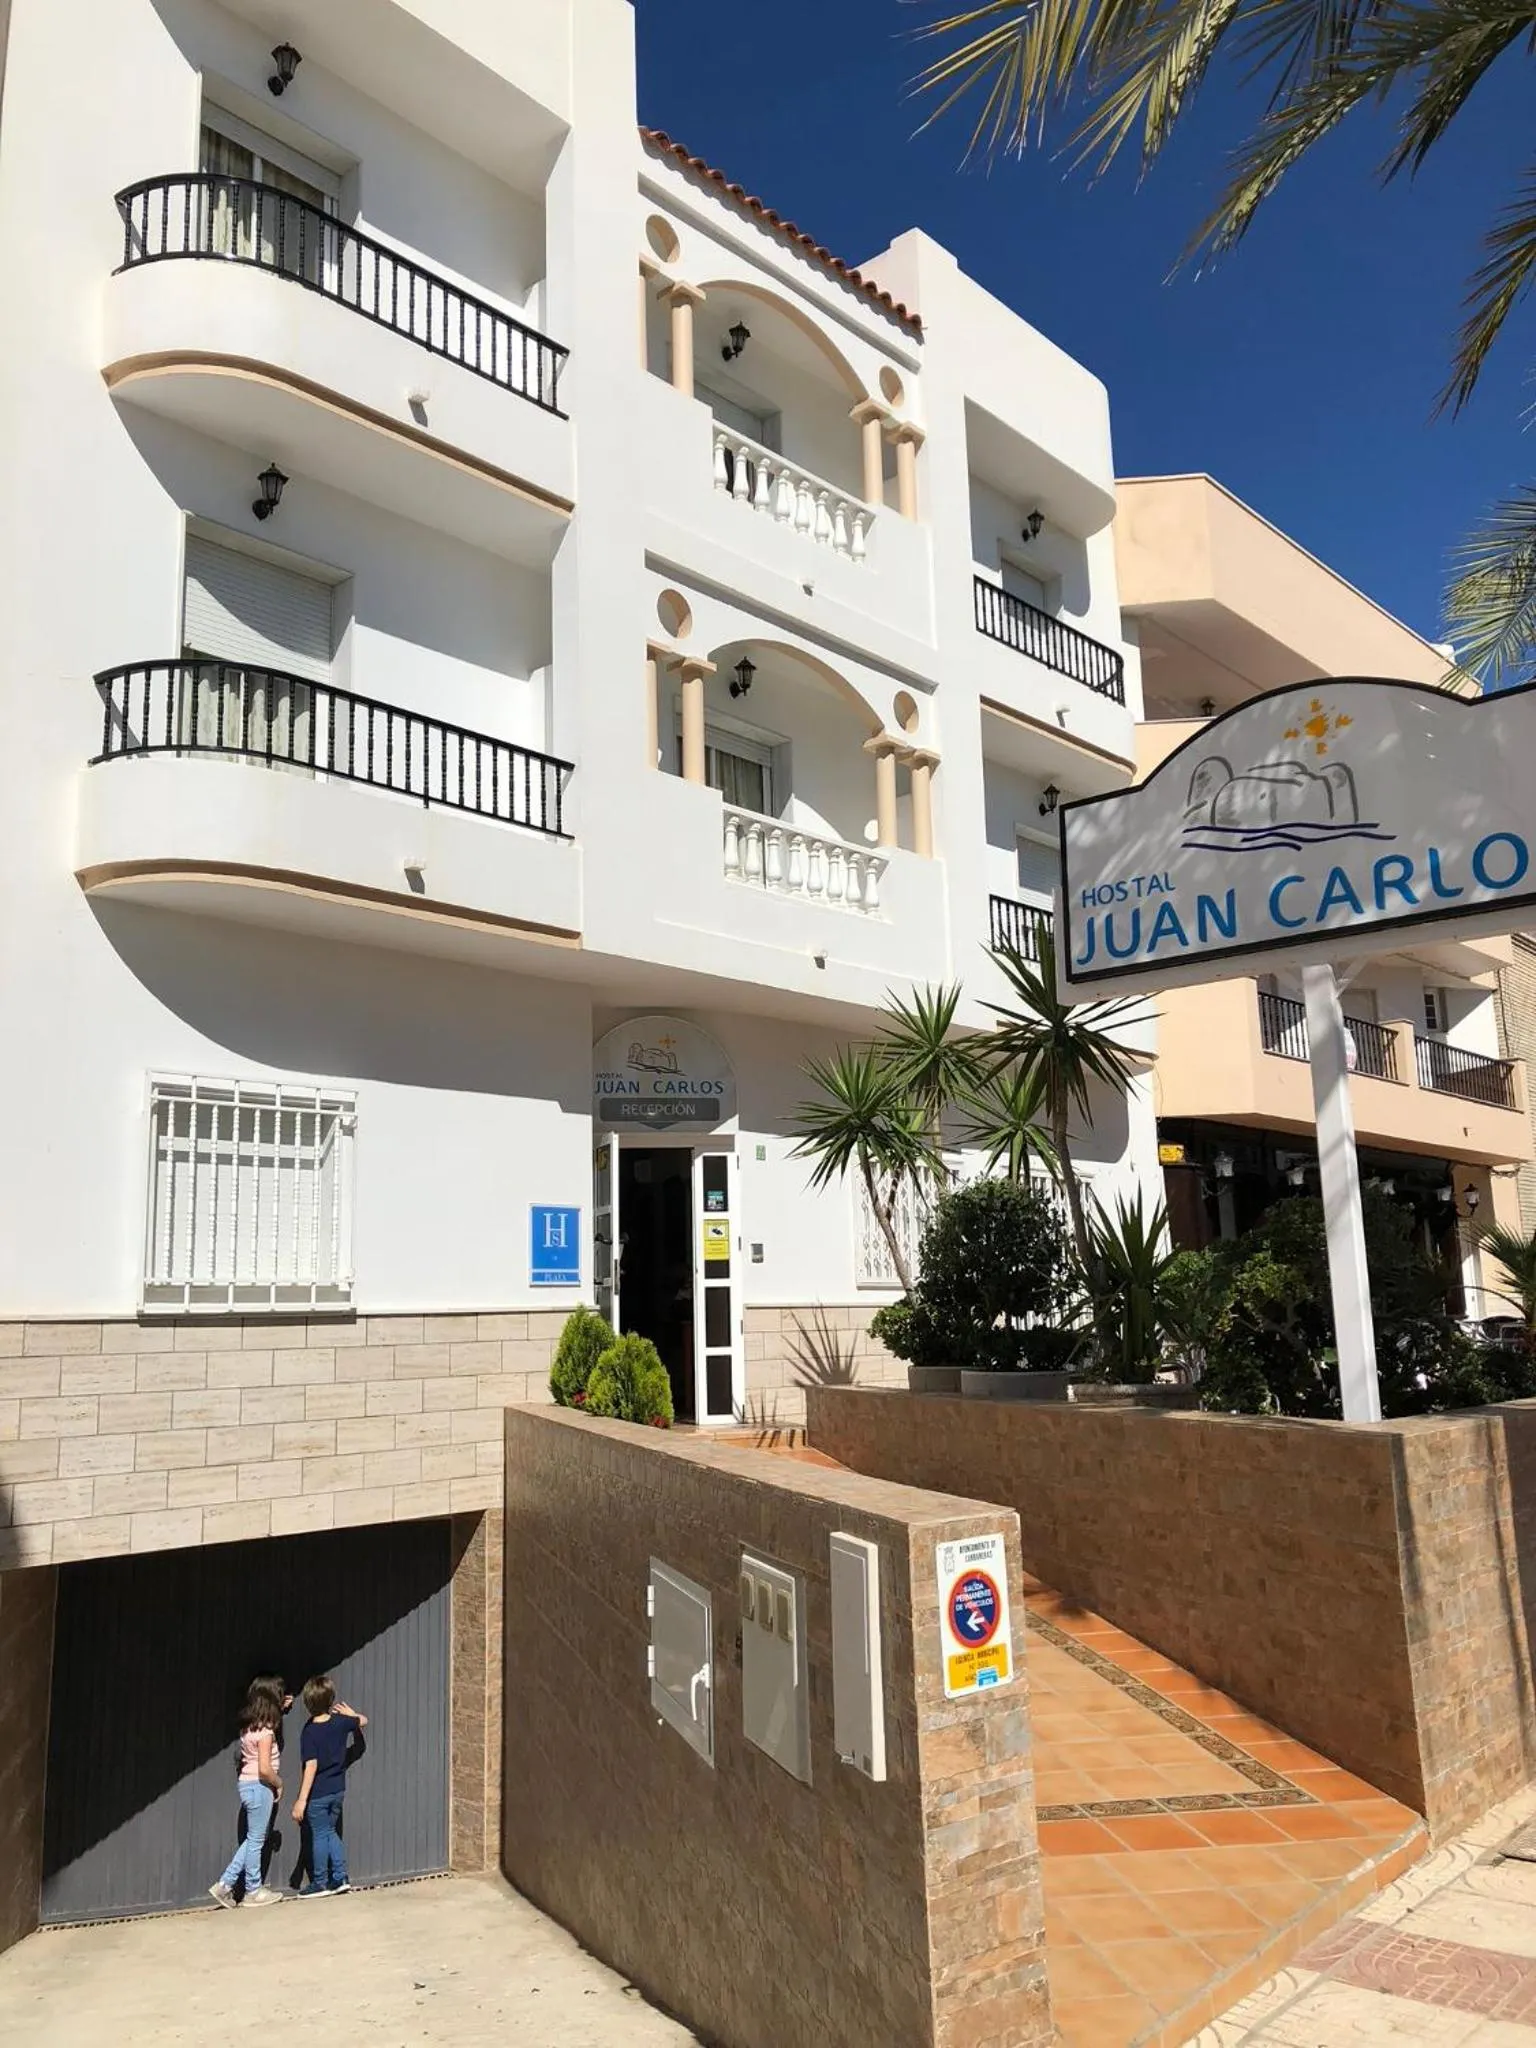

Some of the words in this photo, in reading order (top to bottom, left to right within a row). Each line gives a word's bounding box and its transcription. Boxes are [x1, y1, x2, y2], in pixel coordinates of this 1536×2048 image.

[1075, 887, 1238, 966] JUAN
[1269, 832, 1530, 928] CARLO
[1081, 872, 1176, 909] HOSTAL
[594, 1080, 640, 1095] JUAN
[652, 1080, 724, 1095] CARLOS
[621, 1101, 697, 1116] RECEPCIÓN
